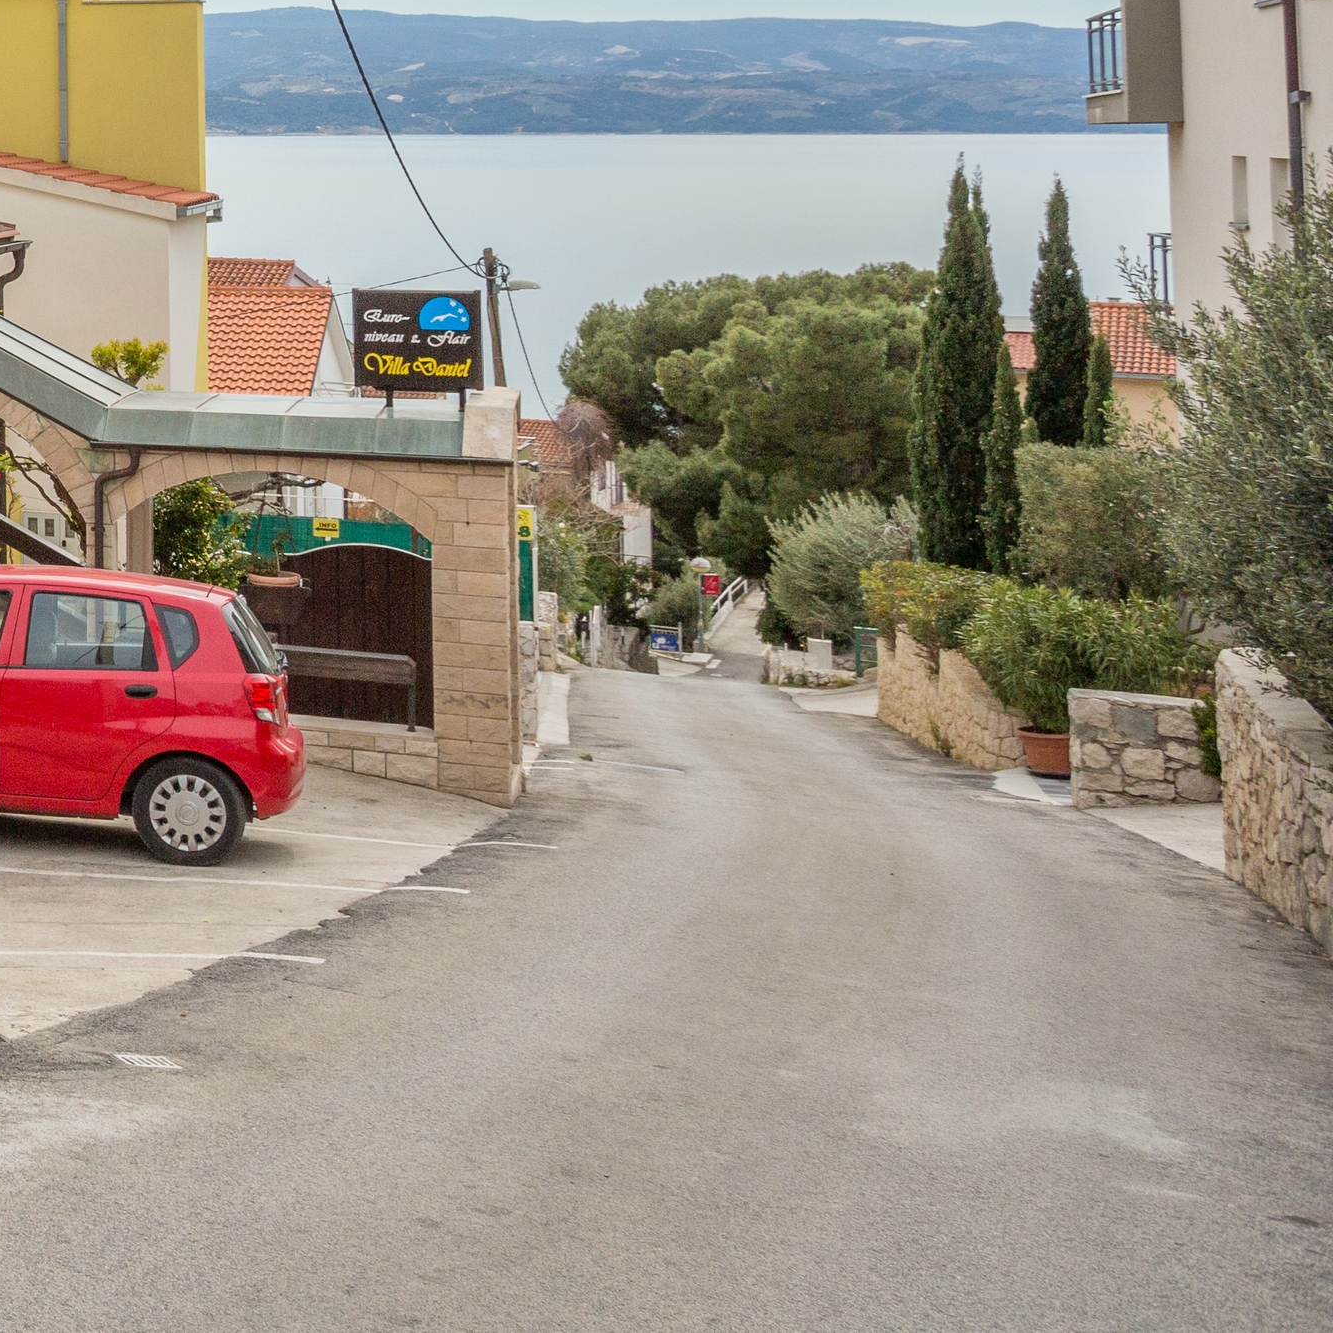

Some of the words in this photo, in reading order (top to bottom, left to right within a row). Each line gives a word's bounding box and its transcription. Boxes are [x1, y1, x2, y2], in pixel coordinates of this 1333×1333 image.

[363, 309, 410, 323] Euro-
[364, 331, 405, 343] niveau
[427, 330, 472, 347] Flair
[364, 352, 411, 376] Villa
[413, 356, 472, 377] Daniel
